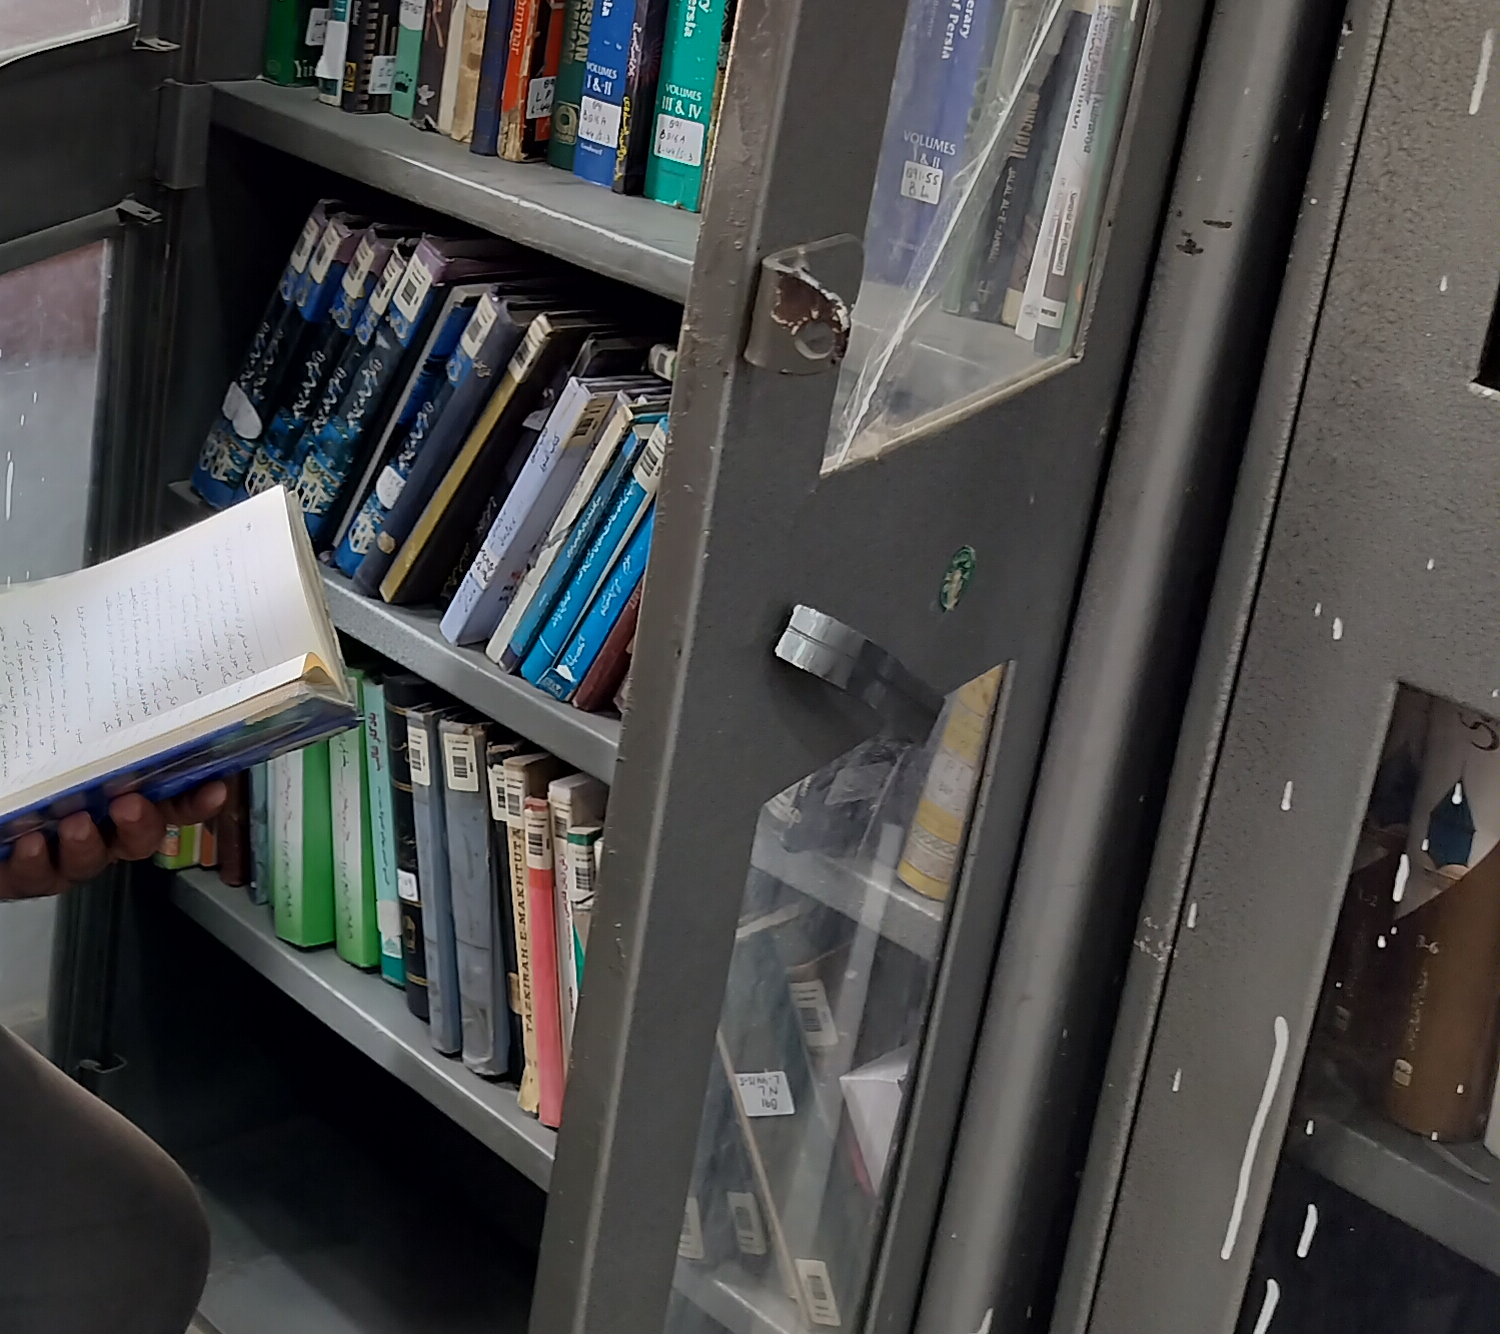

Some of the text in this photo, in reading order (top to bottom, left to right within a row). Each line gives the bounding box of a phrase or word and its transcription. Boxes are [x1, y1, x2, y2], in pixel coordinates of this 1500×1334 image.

[941, 12, 960, 60] Persia
[586, 60, 618, 79] VOLUMES
[664, 82, 703, 102] VOLUMES
[661, 95, 703, 120] III & IV
[903, 129, 956, 156] VOLUMES
[512, 827, 533, 1034] TAZKIRAH-E-MAKHTUTA
